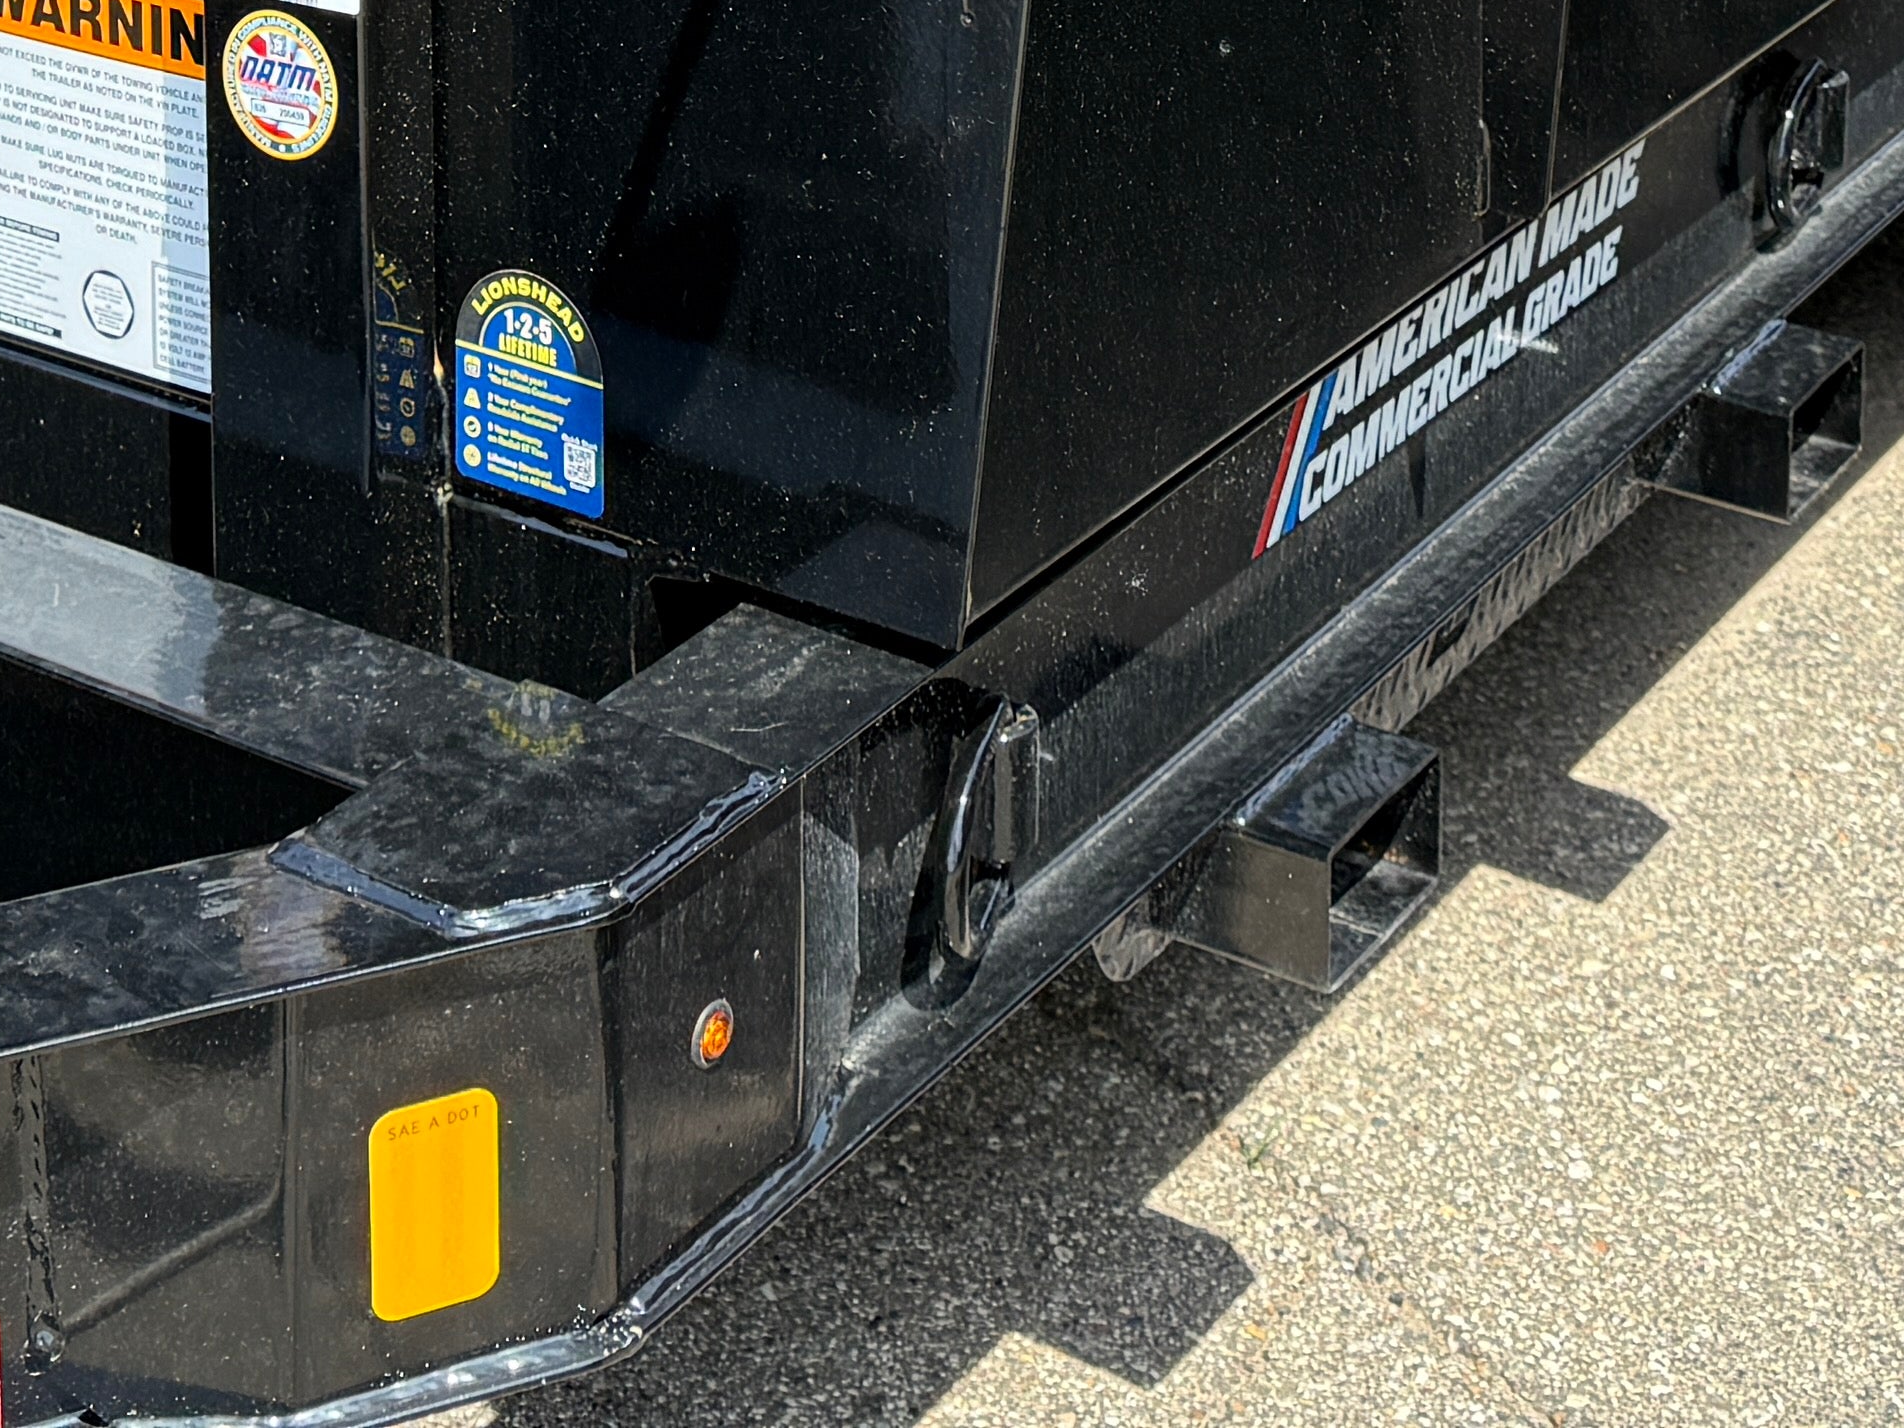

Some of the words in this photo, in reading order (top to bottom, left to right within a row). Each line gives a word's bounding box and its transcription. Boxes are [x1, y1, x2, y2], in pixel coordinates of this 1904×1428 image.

[48, 72, 81, 89] TRAILER
[1323, 218, 1539, 430] AMERICAN
[1539, 137, 1646, 269] MADE
[471, 277, 585, 344] LIONSHEAD
[498, 333, 558, 368] LIFETIME
[1298, 306, 1524, 523] COMMERCIAL
[1522, 226, 1623, 341] GRADE
[388, 1120, 421, 1141] SAE
[429, 1116, 440, 1130] A
[447, 1105, 480, 1125] DOT
